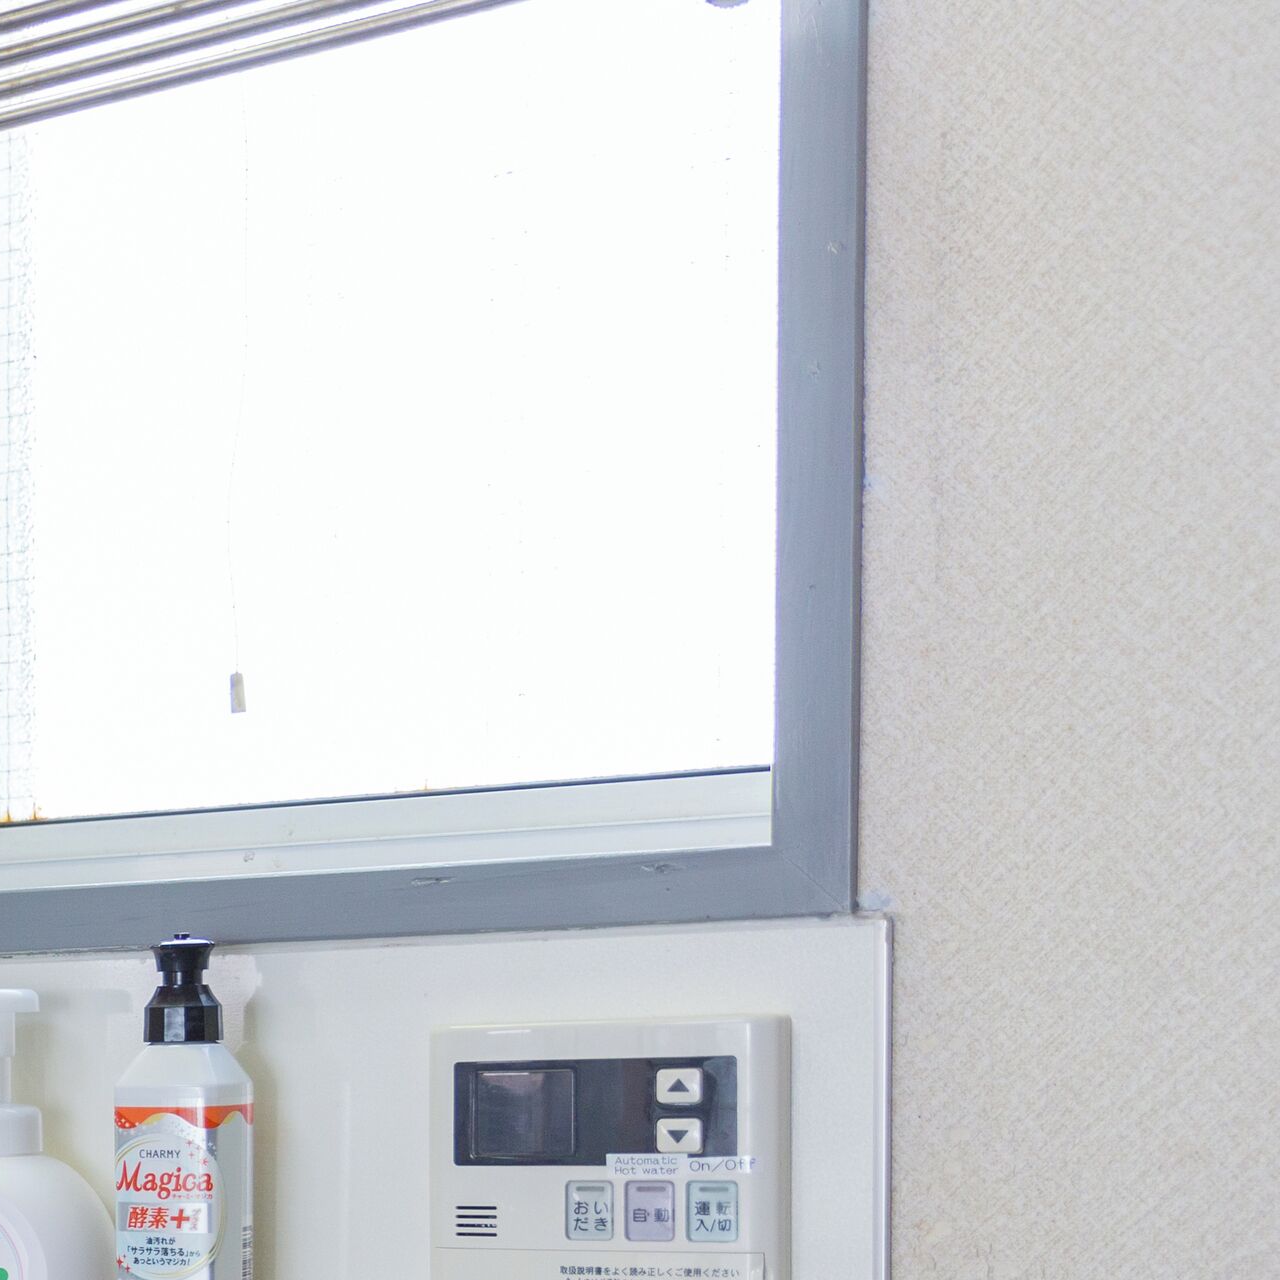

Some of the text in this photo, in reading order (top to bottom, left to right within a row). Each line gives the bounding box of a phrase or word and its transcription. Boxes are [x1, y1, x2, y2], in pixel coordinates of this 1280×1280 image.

[139, 1149, 181, 1159] CHARMY
[614, 1155, 678, 1166] Automatic
[614, 1166, 680, 1176] Hot water
[689, 1158, 757, 1173] On/Off
[116, 1160, 214, 1199] Magica
[694, 1201, 732, 1216] 運転
[694, 1218, 732, 1232] 入/切
[146, 1236, 176, 1246] 油汚れが
[559, 1265, 740, 1278] 取扱説明書をよく読み正しくご使用ください
